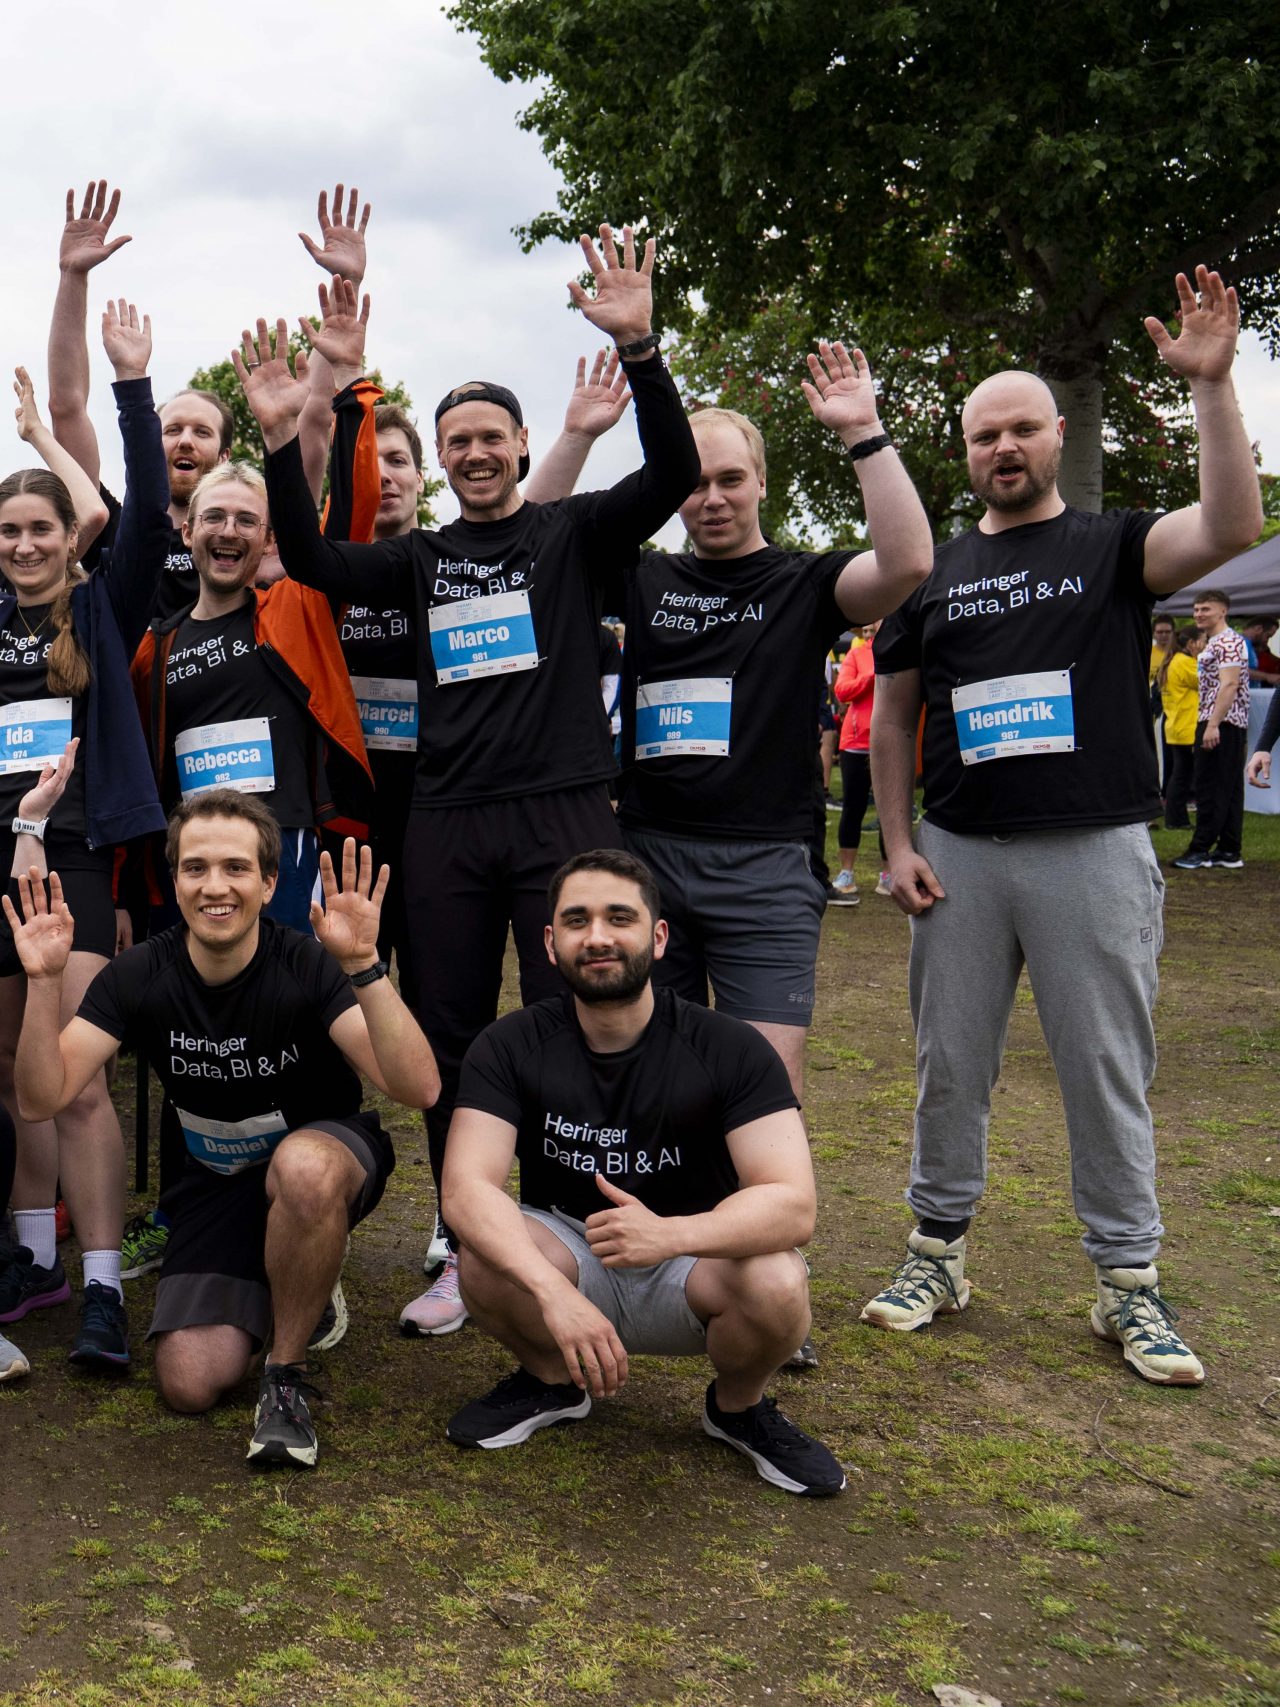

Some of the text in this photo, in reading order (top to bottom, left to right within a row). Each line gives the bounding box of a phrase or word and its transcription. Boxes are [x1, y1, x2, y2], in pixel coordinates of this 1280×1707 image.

[437, 558, 505, 579] Heringer
[487, 576, 507, 596] BI
[511, 571, 526, 586] &
[948, 570, 1030, 599] Heringer
[660, 591, 728, 612] Heringer
[948, 575, 1084, 622] Data, BI & AI
[341, 618, 408, 641] Data, BI
[651, 610, 698, 634] Data,
[741, 603, 763, 622] AI
[448, 625, 510, 651] Marco
[23, 649, 40, 665] BI
[166, 635, 225, 666] eringer
[472, 651, 488, 662] 981
[166, 640, 250, 686] ata, BI &
[658, 706, 694, 727] Nils
[968, 701, 1056, 732] Hendrik
[6, 727, 34, 746] Ida
[374, 727, 389, 736] 990
[666, 731, 681, 740] 989
[1000, 730, 1020, 741] 987
[13, 750, 27, 759] 974
[184, 747, 261, 775] Rebecca
[215, 772, 230, 783] 982
[170, 1030, 247, 1057] Heringer
[171, 1043, 299, 1082] Data, BI & AI
[544, 1112, 627, 1147] Heringer
[203, 1136, 269, 1154] Daniel
[544, 1138, 681, 1175] Data, BI & AI
